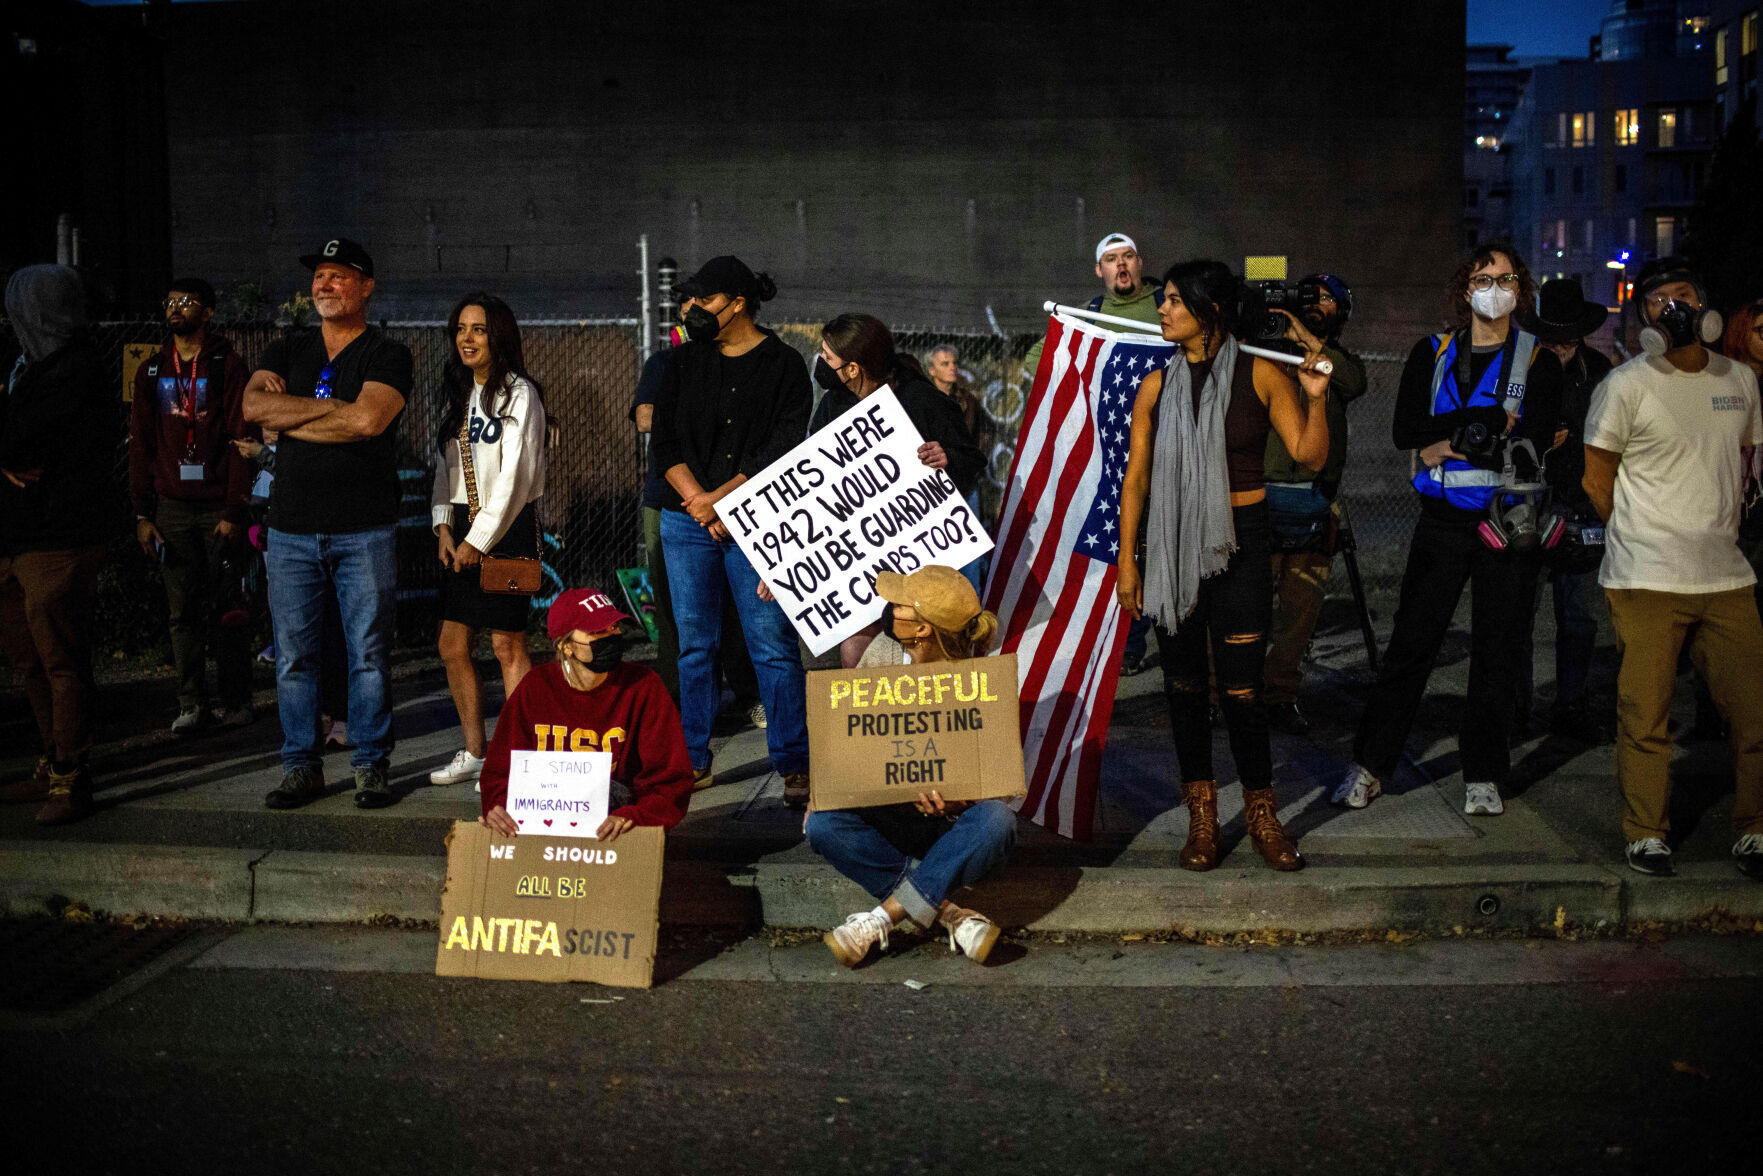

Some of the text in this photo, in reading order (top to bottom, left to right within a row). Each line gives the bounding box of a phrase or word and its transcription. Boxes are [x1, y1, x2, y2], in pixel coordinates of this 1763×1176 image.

[323, 240, 340, 257] G
[1711, 395, 1745, 405] BIDEN
[728, 403, 895, 537] IF THIS WERE
[753, 453, 901, 571] 1942, WOULD
[772, 468, 956, 602] YOU BE GUARDING
[795, 590, 852, 637] THE
[913, 505, 978, 559] TOO?
[830, 671, 998, 710] PEACEFUL
[891, 737, 939, 758] IS A
[523, 759, 593, 775] I STAND
[514, 797, 591, 813] IMMIGRANTS
[490, 844, 618, 865] WE SHOULD
[516, 875, 586, 898] ALL BE
